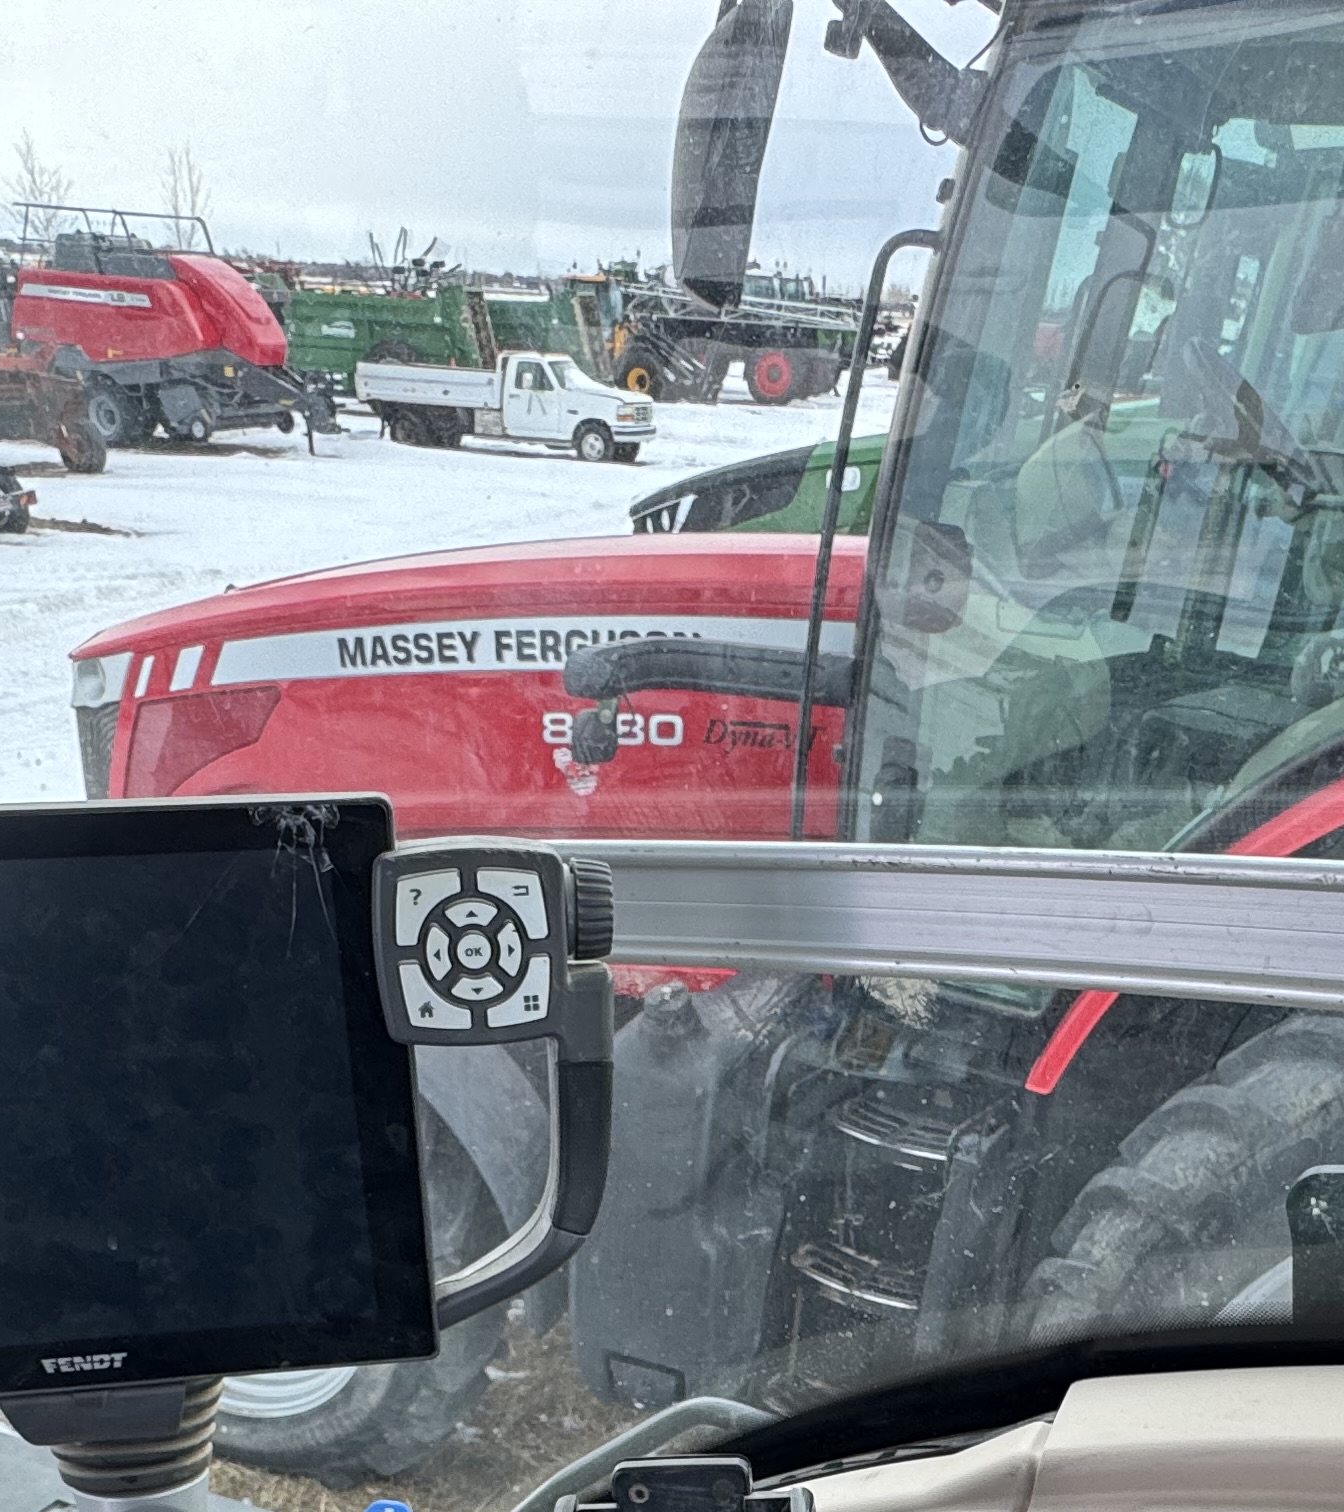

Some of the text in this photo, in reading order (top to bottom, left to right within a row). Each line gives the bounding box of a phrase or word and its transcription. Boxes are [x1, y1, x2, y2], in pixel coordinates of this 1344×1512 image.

[337, 631, 480, 668] MASSEY
[542, 712, 684, 746] 880
[465, 947, 483, 957] OK
[40, 1352, 128, 1374] FENDT
